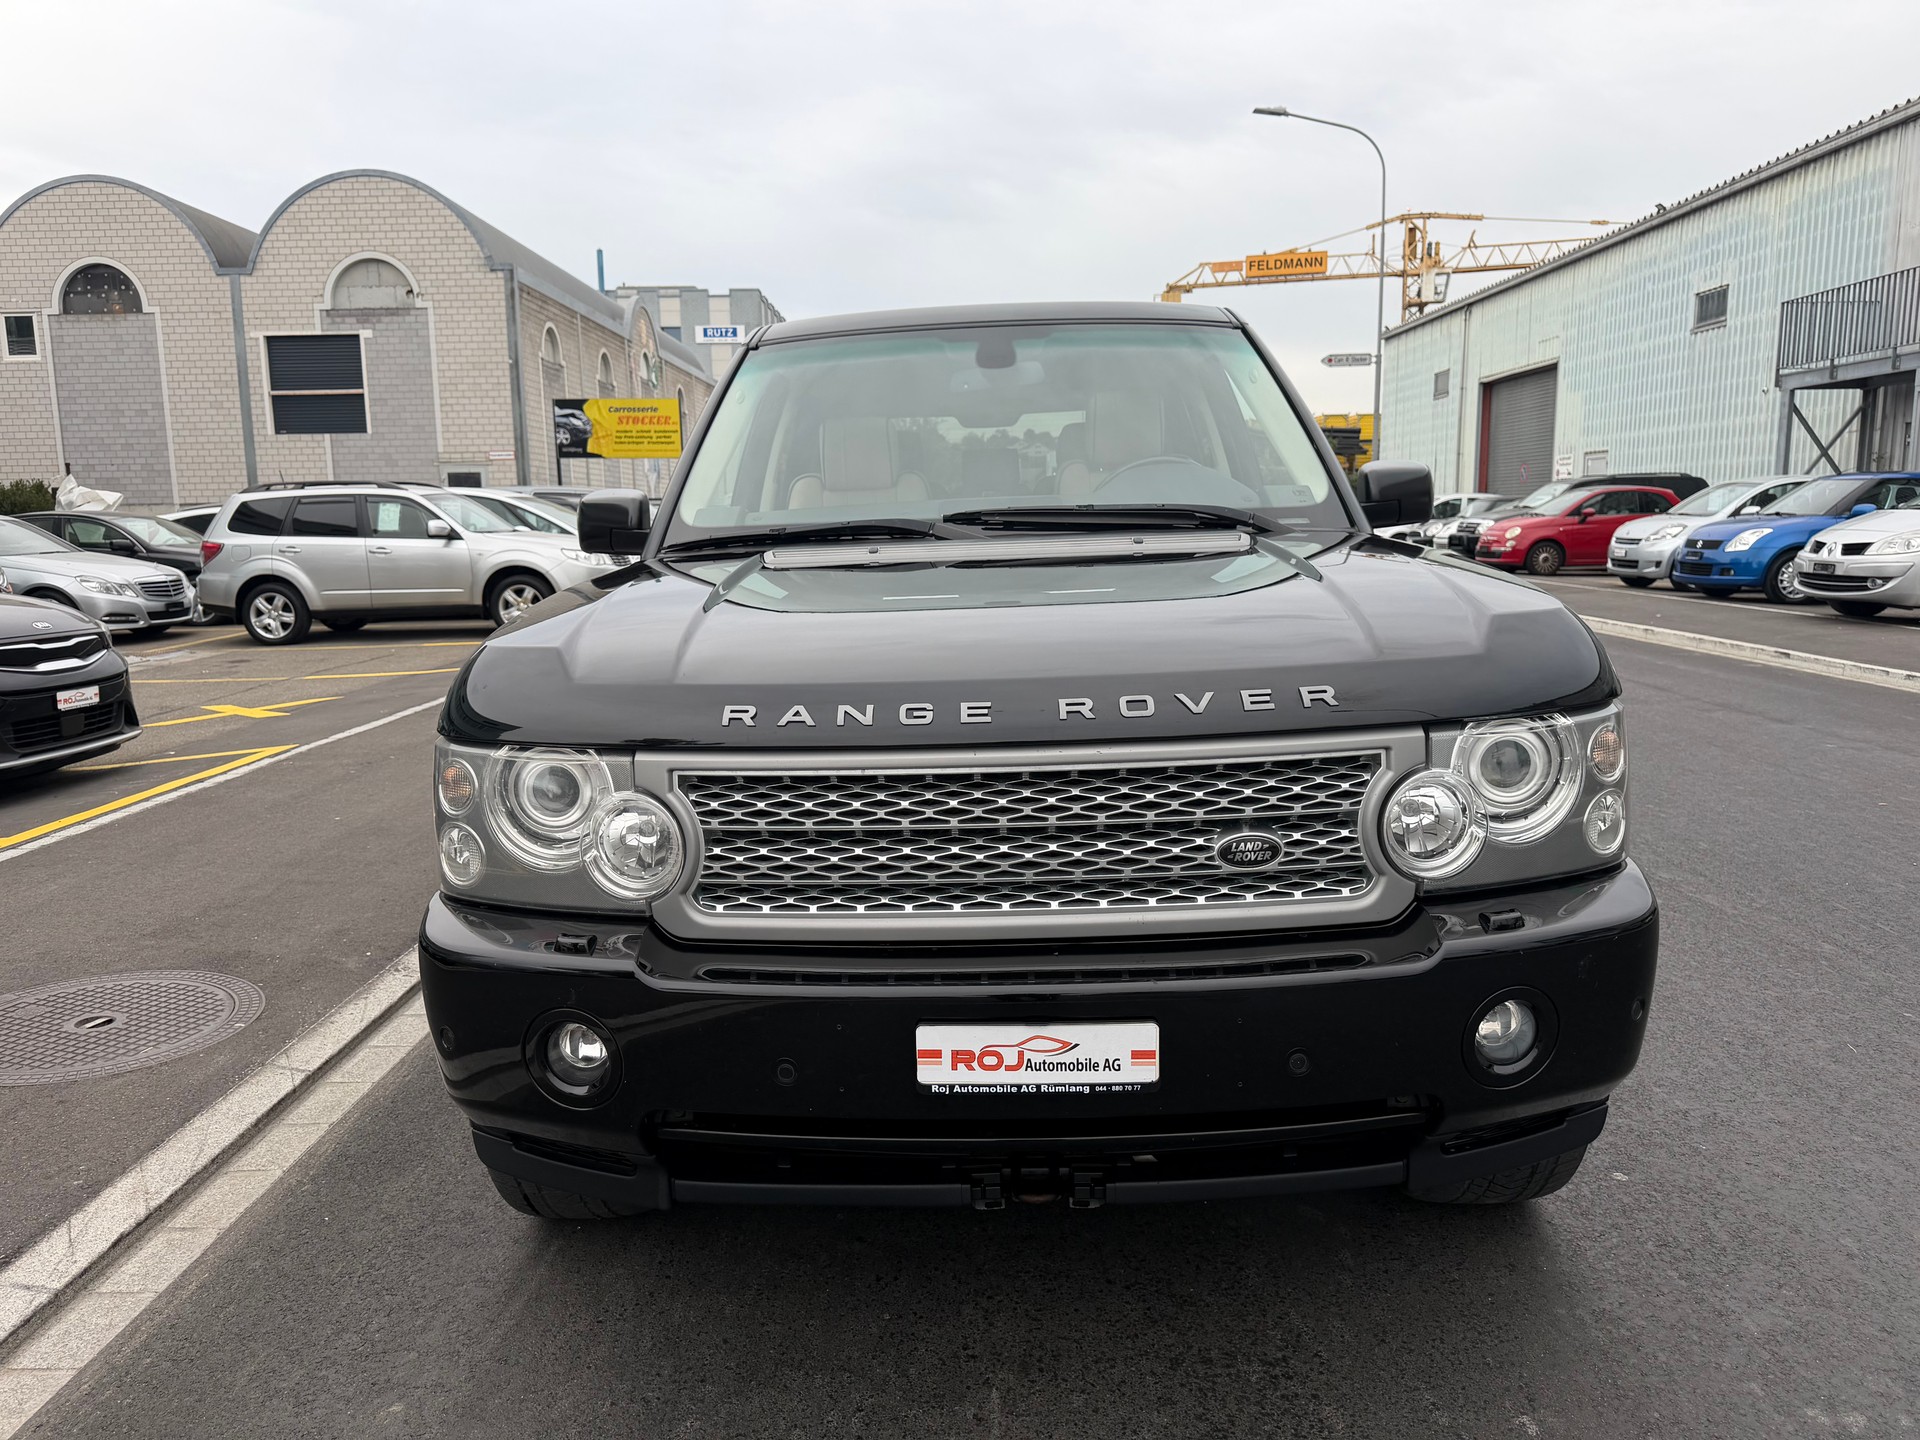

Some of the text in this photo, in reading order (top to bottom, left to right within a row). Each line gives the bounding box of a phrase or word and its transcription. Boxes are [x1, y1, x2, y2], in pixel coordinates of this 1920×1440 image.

[1249, 256, 1323, 272] FELDMANN
[706, 328, 734, 337] RUTZ
[617, 415, 671, 426] STOCKER
[721, 685, 1340, 727] RANGE ROVER
[1231, 841, 1262, 852] LAND
[1234, 850, 1272, 862] ROVER
[950, 1049, 1121, 1072] ROJ Automobile AG
[931, 1084, 950, 1095] Roj
[953, 1084, 1018, 1093] Automobile
[1020, 1084, 1037, 1093] AG
[1041, 1084, 1090, 1094] Rümlang
